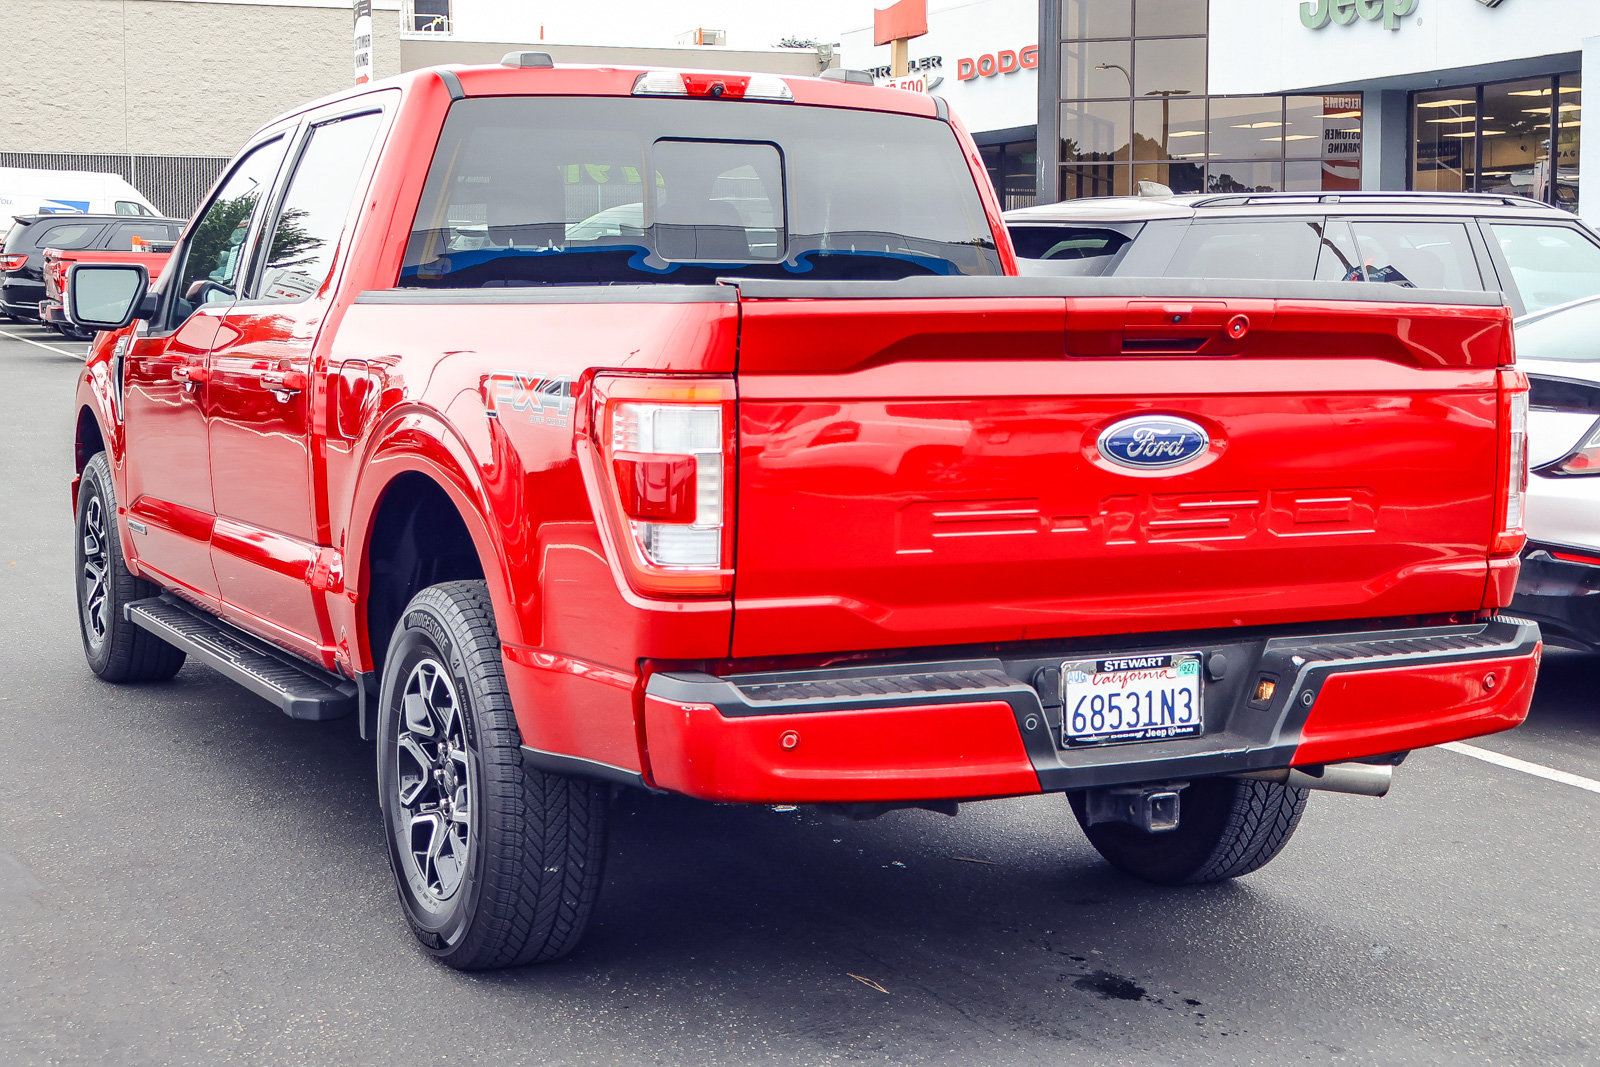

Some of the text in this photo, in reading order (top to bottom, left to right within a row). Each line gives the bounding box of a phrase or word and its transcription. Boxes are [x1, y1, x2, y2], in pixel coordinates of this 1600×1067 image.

[862, 55, 942, 79] HRLER
[957, 44, 1039, 82] DODG
[483, 370, 571, 418] FX4
[1127, 427, 1186, 458] Ford
[896, 486, 1377, 554] F-150
[408, 612, 449, 651] BRIDGESTONE
[1068, 671, 1087, 683] AUG
[1092, 669, 1176, 689] California
[1104, 657, 1164, 671] STEWART
[1072, 687, 1193, 732] 68531N3
[1145, 728, 1167, 738] Jeep
